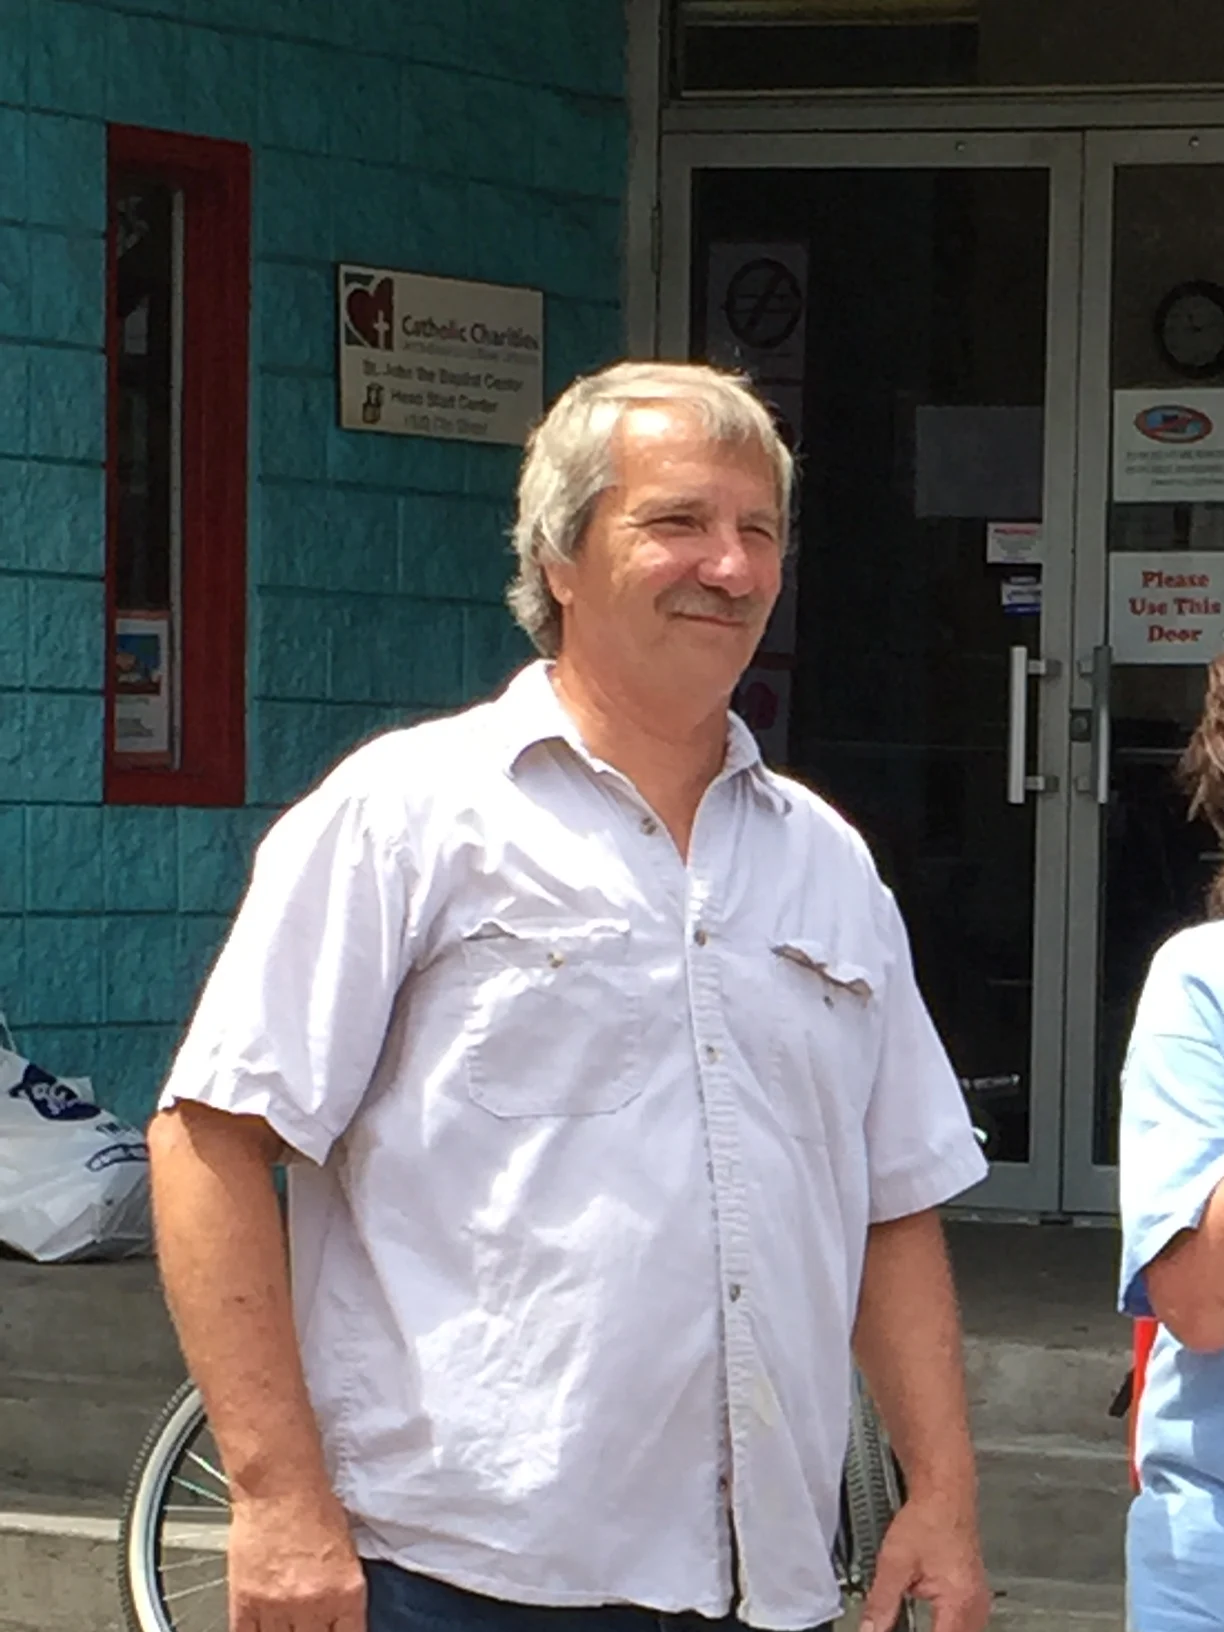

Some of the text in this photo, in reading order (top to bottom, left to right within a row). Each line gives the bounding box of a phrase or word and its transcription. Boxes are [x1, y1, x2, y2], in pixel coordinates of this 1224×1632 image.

[402, 314, 538, 351] Catholic Charities
[1142, 570, 1210, 588] Please
[1129, 597, 1222, 616] Use This
[1148, 624, 1203, 643] Door
